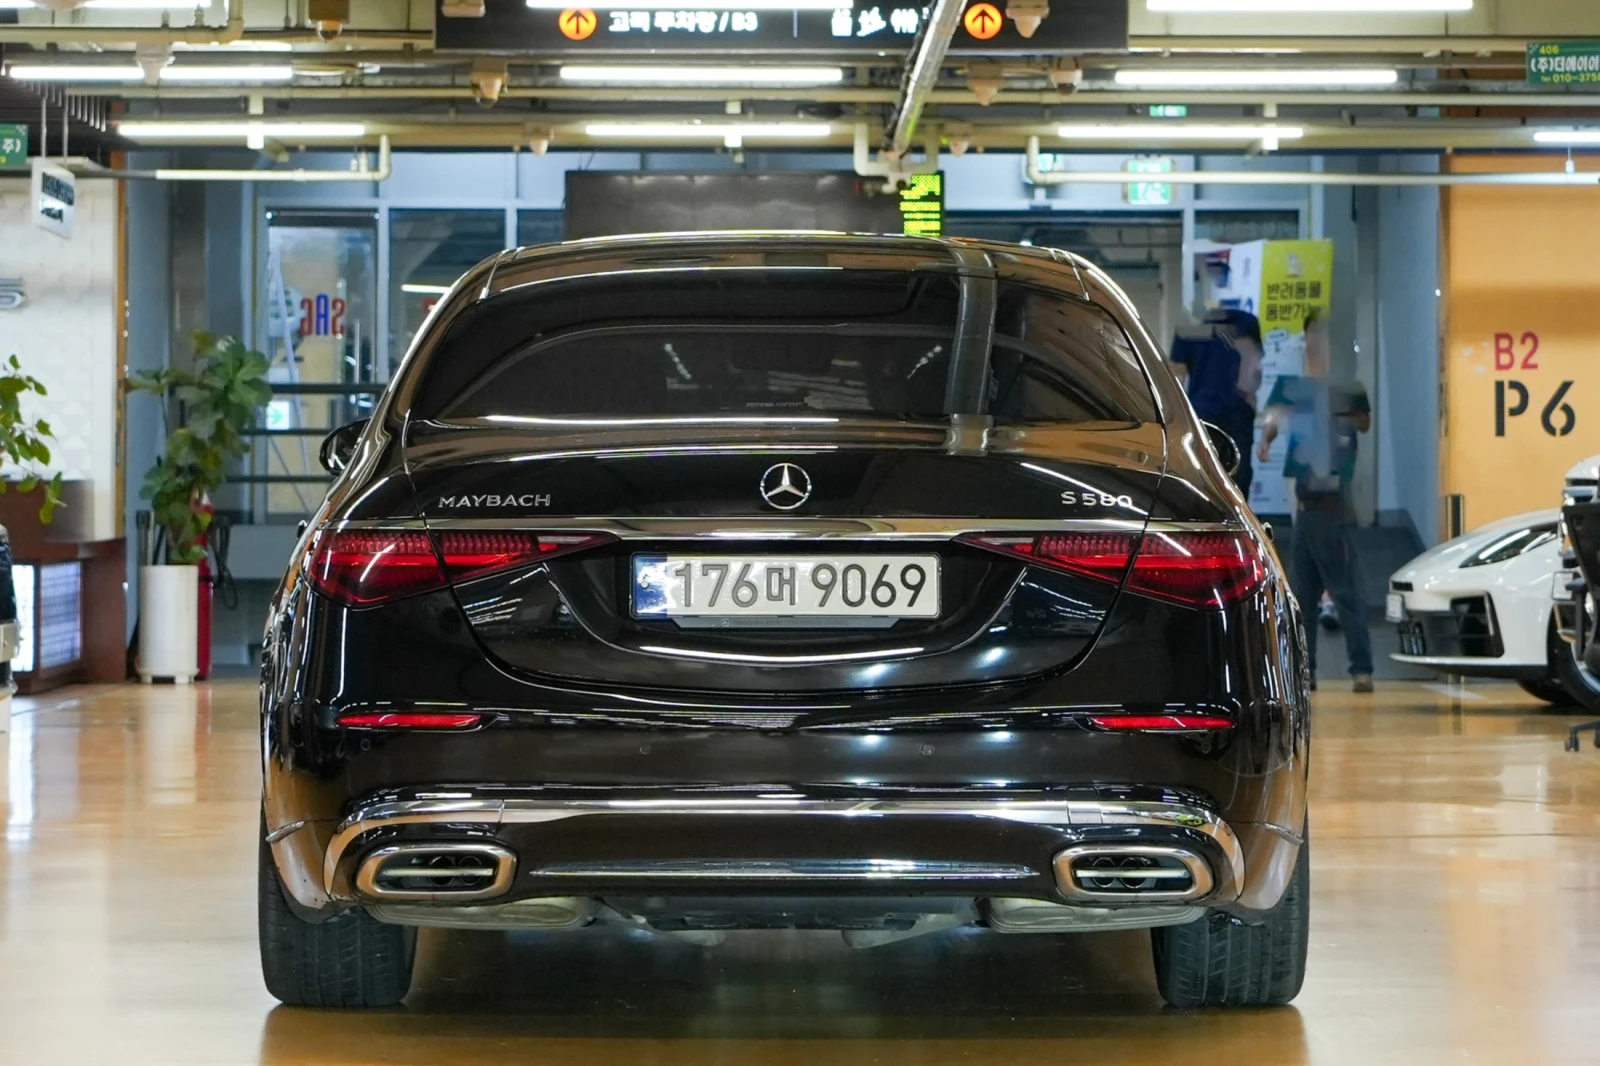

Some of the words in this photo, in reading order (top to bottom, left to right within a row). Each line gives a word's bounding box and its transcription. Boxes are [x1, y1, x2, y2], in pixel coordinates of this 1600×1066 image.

[1267, 281, 1321, 300] 반려동물
[1494, 331, 1539, 370] B2
[438, 494, 551, 508] MAYBACH
